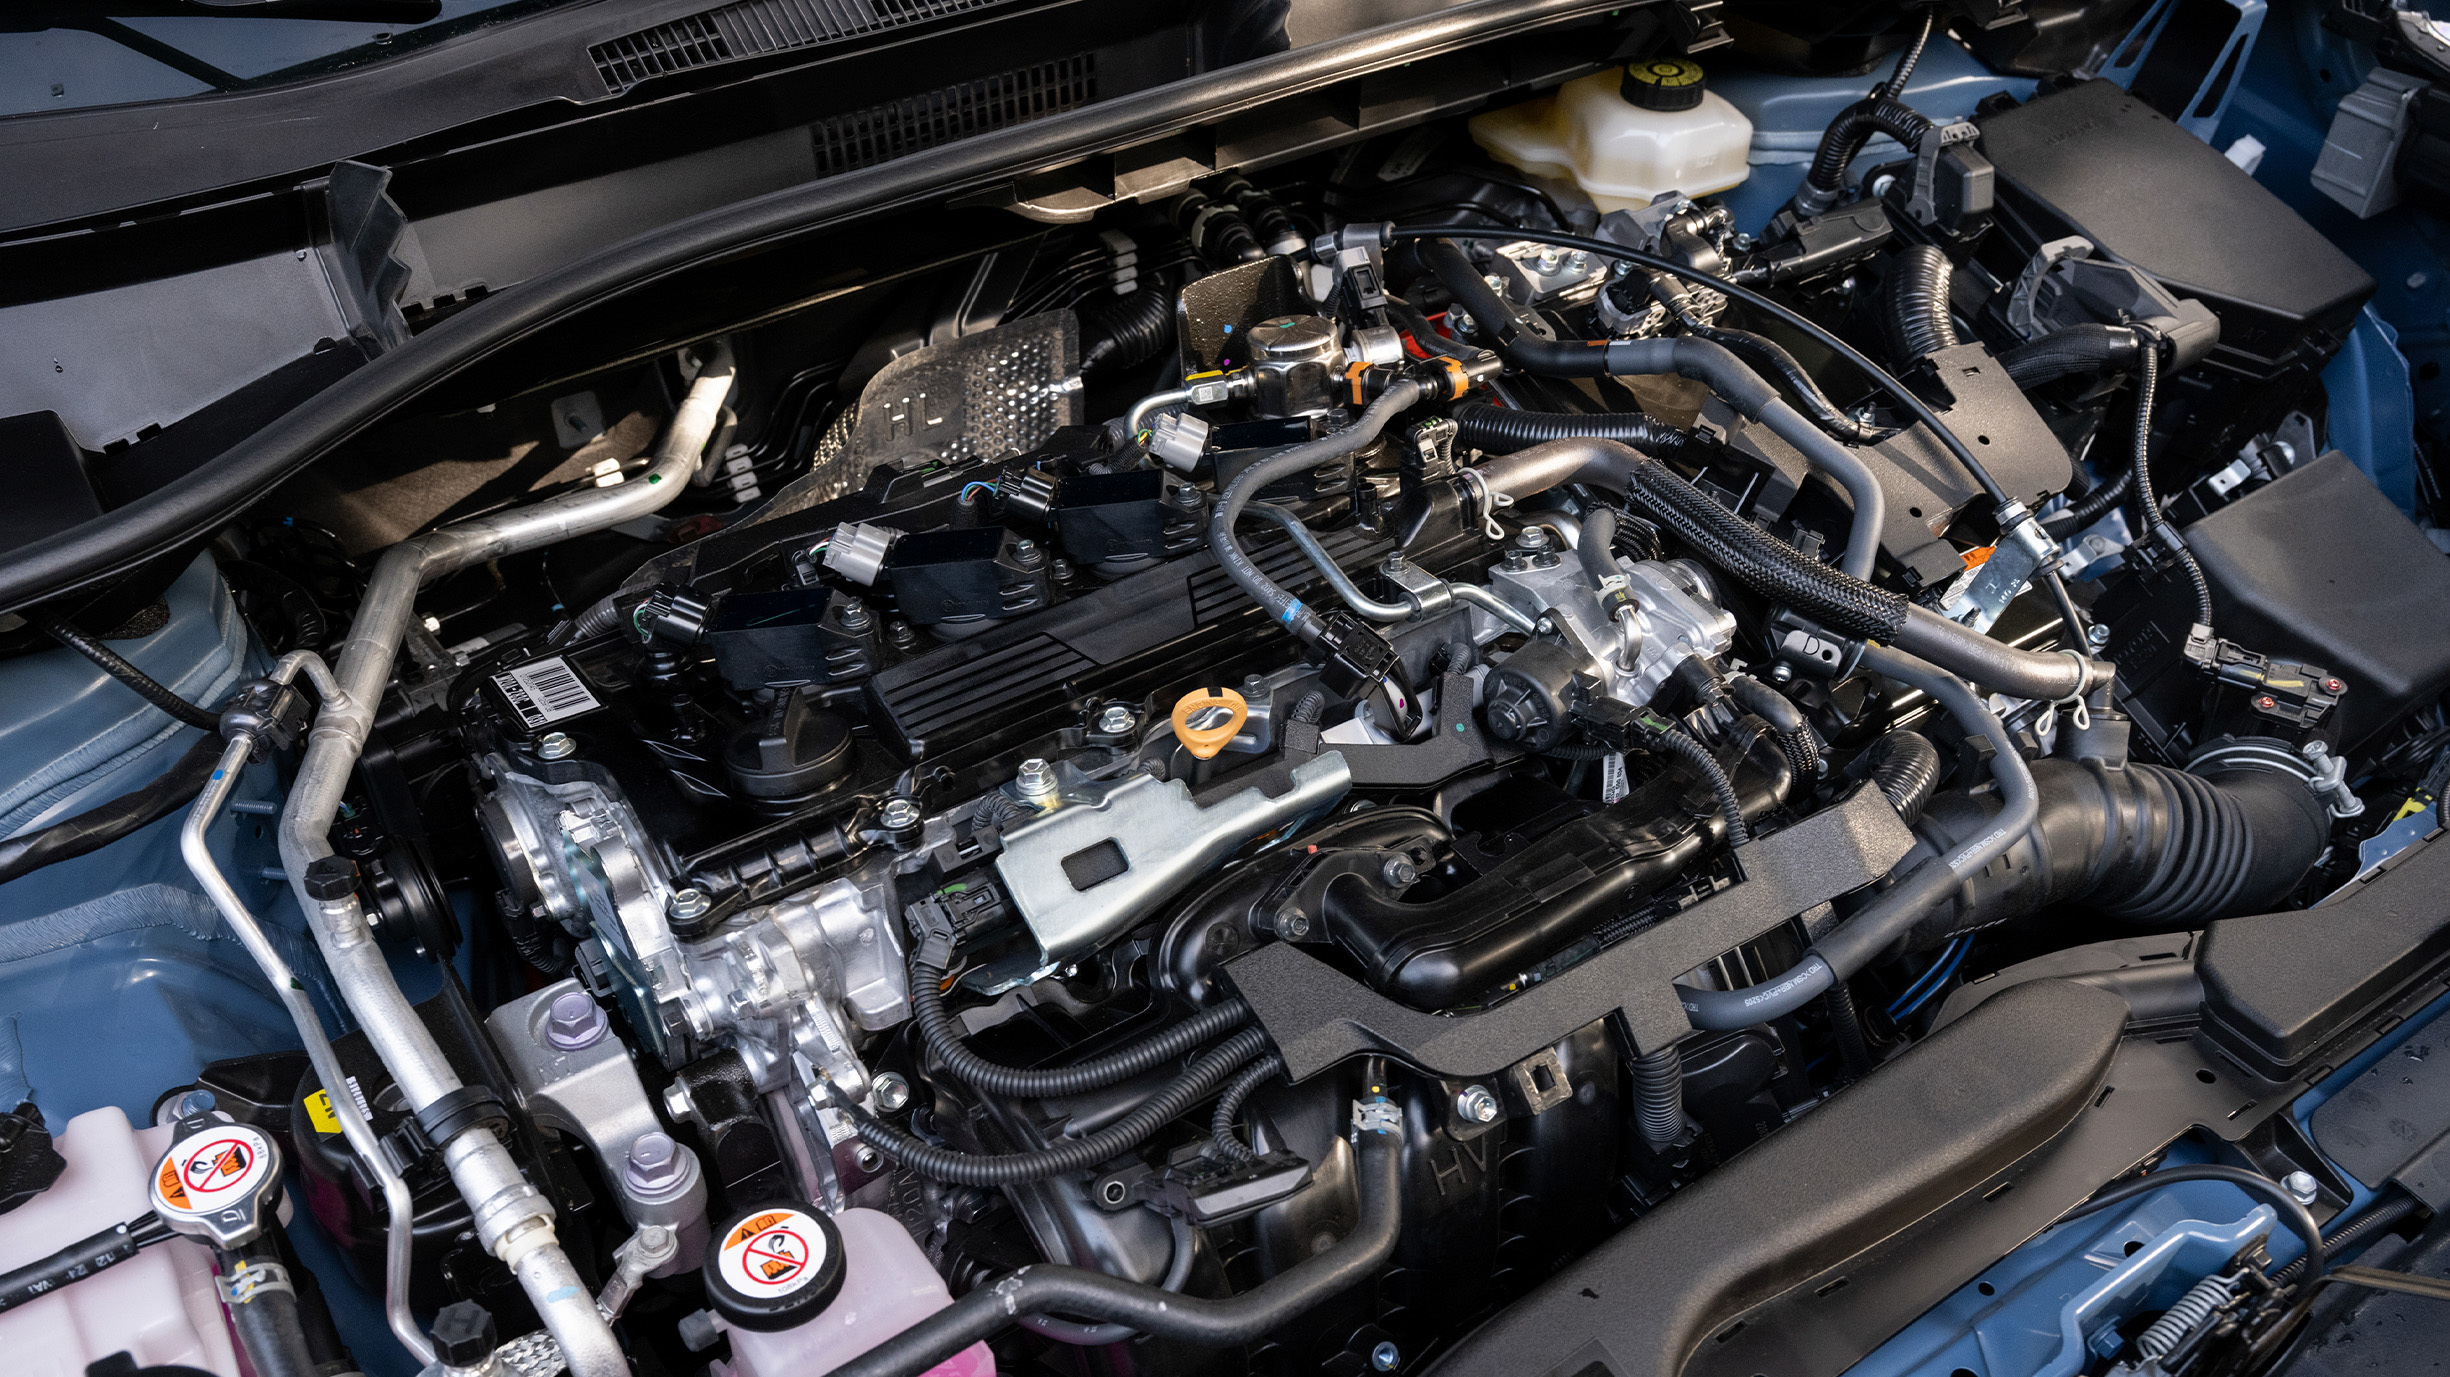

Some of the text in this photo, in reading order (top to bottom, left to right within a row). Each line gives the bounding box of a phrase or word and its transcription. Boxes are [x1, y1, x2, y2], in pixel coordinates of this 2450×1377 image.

[883, 392, 942, 441] HL
[1241, 565, 1254, 578] NOT
[1182, 698, 1242, 715] ENGINE OIL
[1808, 962, 1822, 977] TRD
[1430, 1133, 1487, 1196] HV
[777, 1275, 809, 1294] 108kPa
